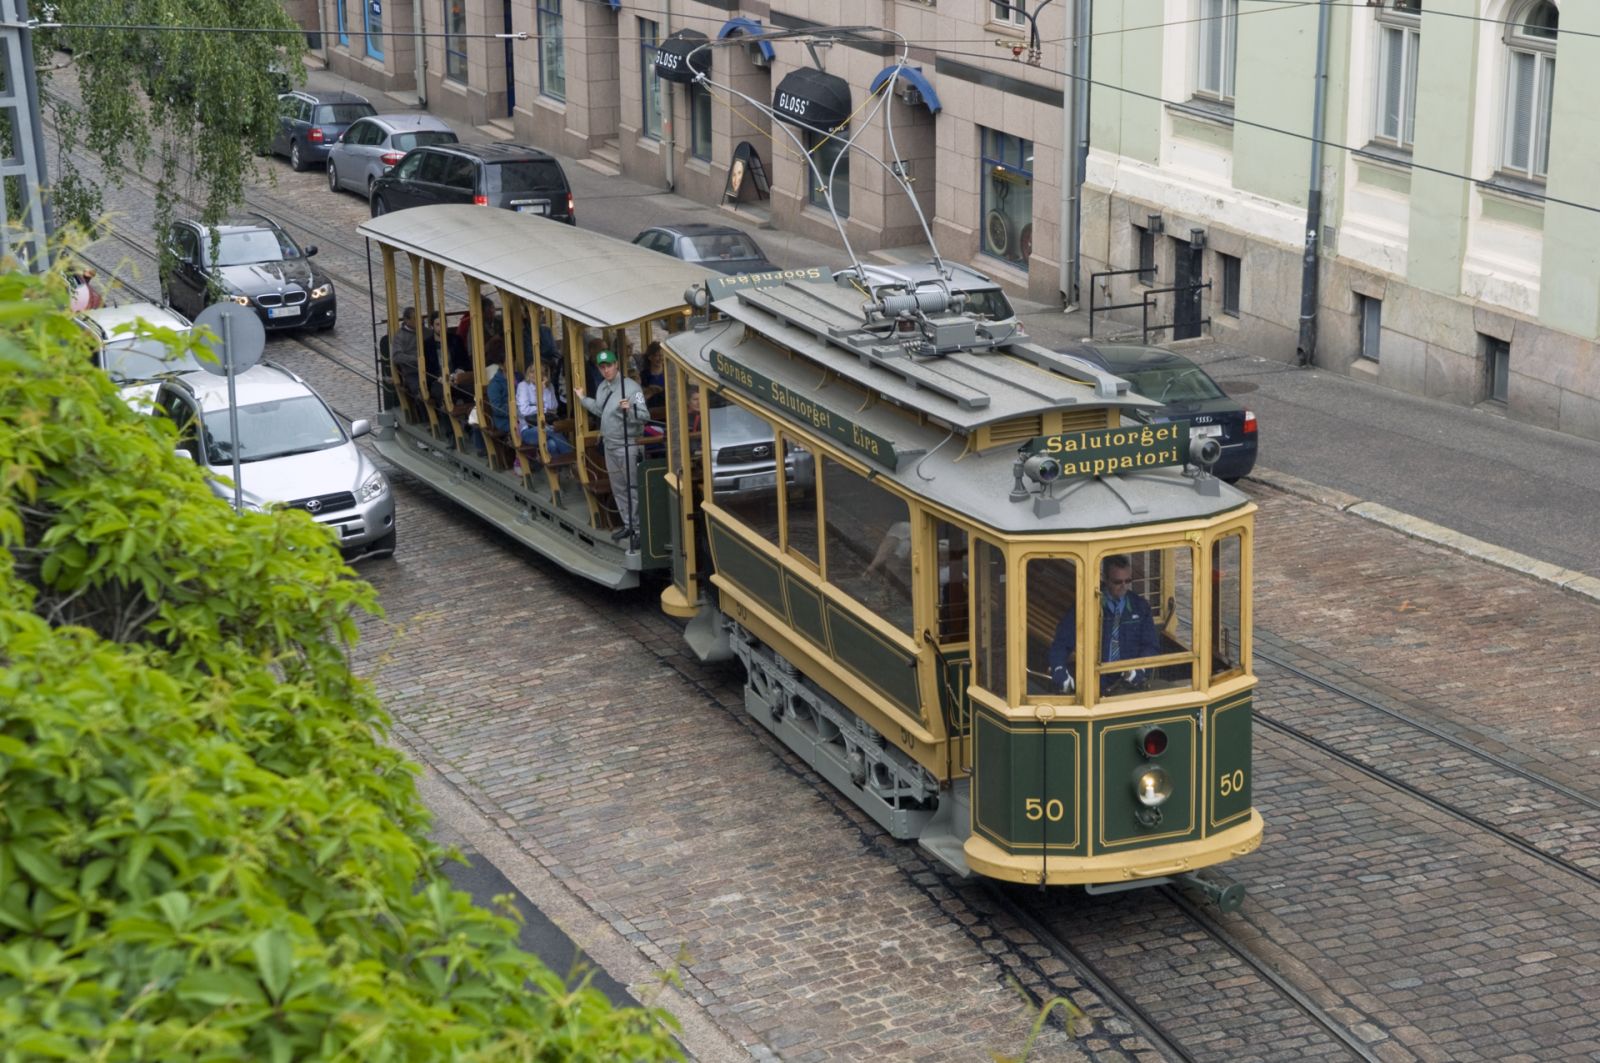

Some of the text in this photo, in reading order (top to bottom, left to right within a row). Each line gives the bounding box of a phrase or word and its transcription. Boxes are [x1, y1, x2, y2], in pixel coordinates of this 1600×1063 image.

[771, 381, 832, 429] Salutorget
[852, 423, 879, 455] Eira
[1047, 424, 1179, 454] Salutorget
[1057, 446, 1178, 476] auppatori
[1220, 769, 1244, 797] 50
[1025, 798, 1064, 822] 50
